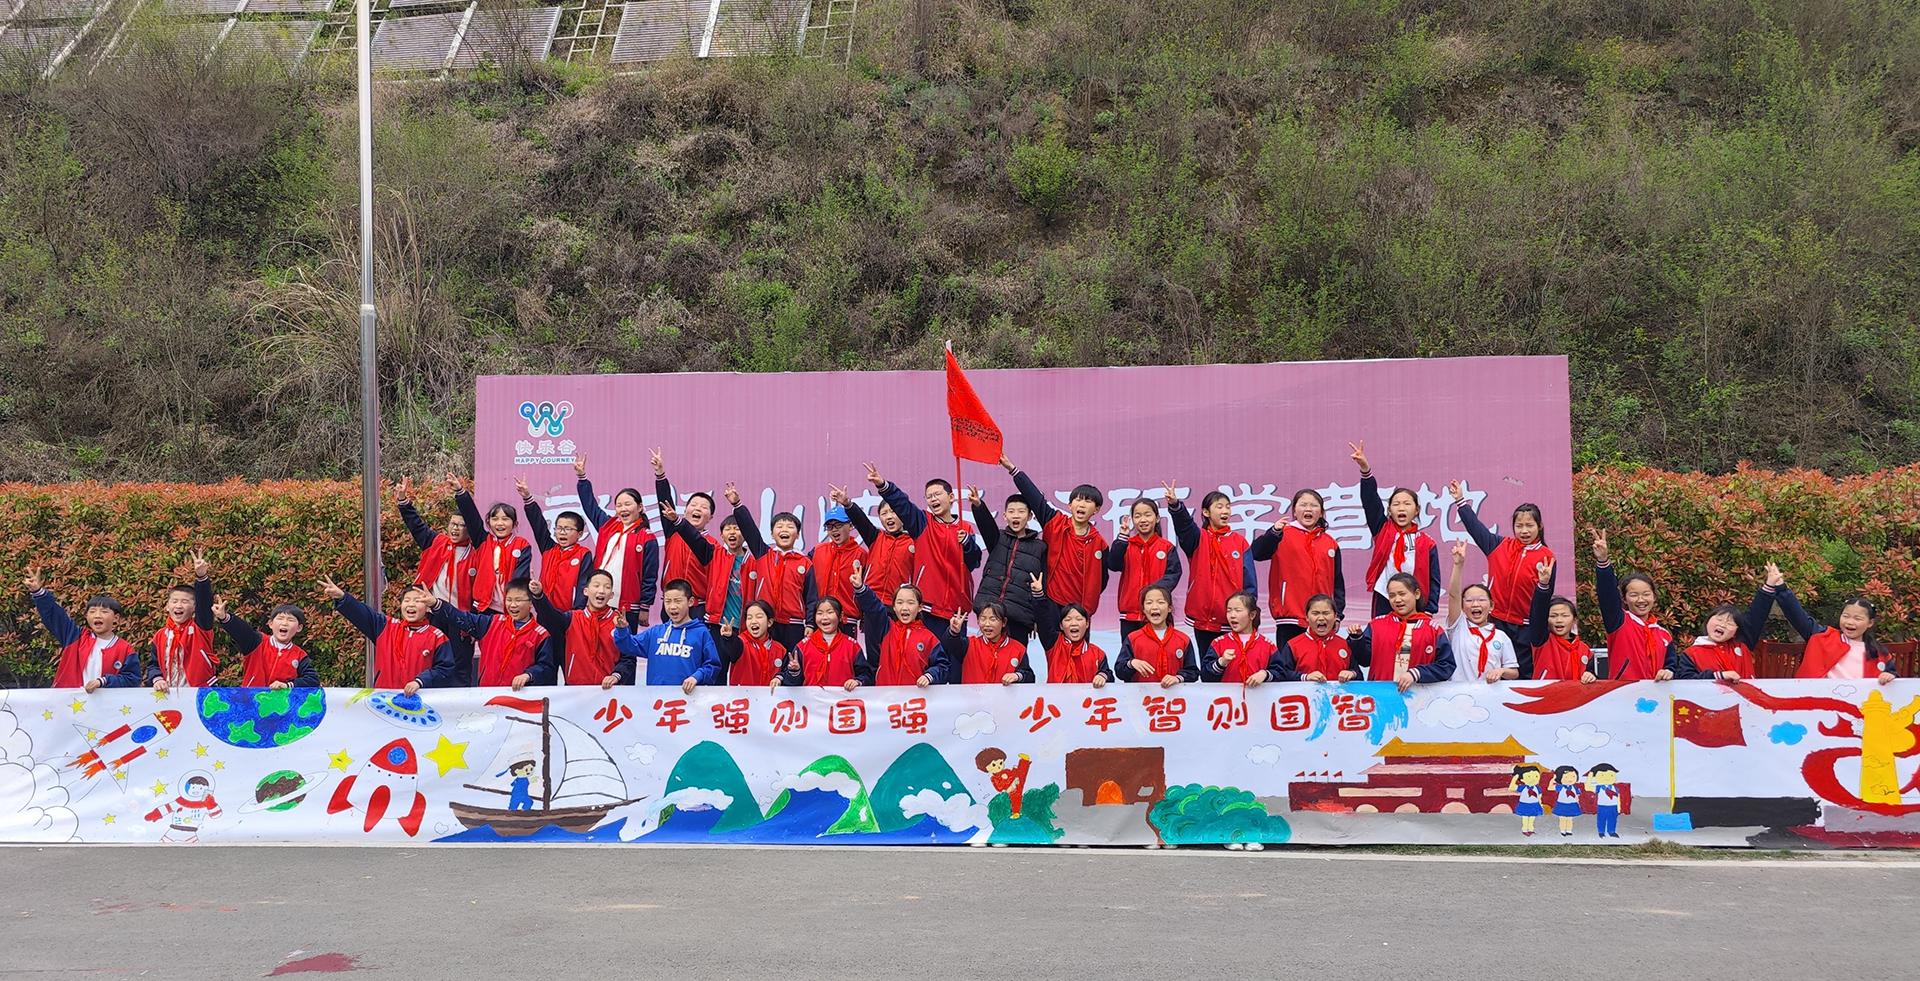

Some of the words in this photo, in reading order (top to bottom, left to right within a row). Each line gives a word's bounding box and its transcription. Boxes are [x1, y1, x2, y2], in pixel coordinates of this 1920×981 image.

[515, 440, 576, 455] 快乐谷
[593, 698, 929, 734] 少年强则国强
[1019, 695, 1375, 733] 少年智则国智
